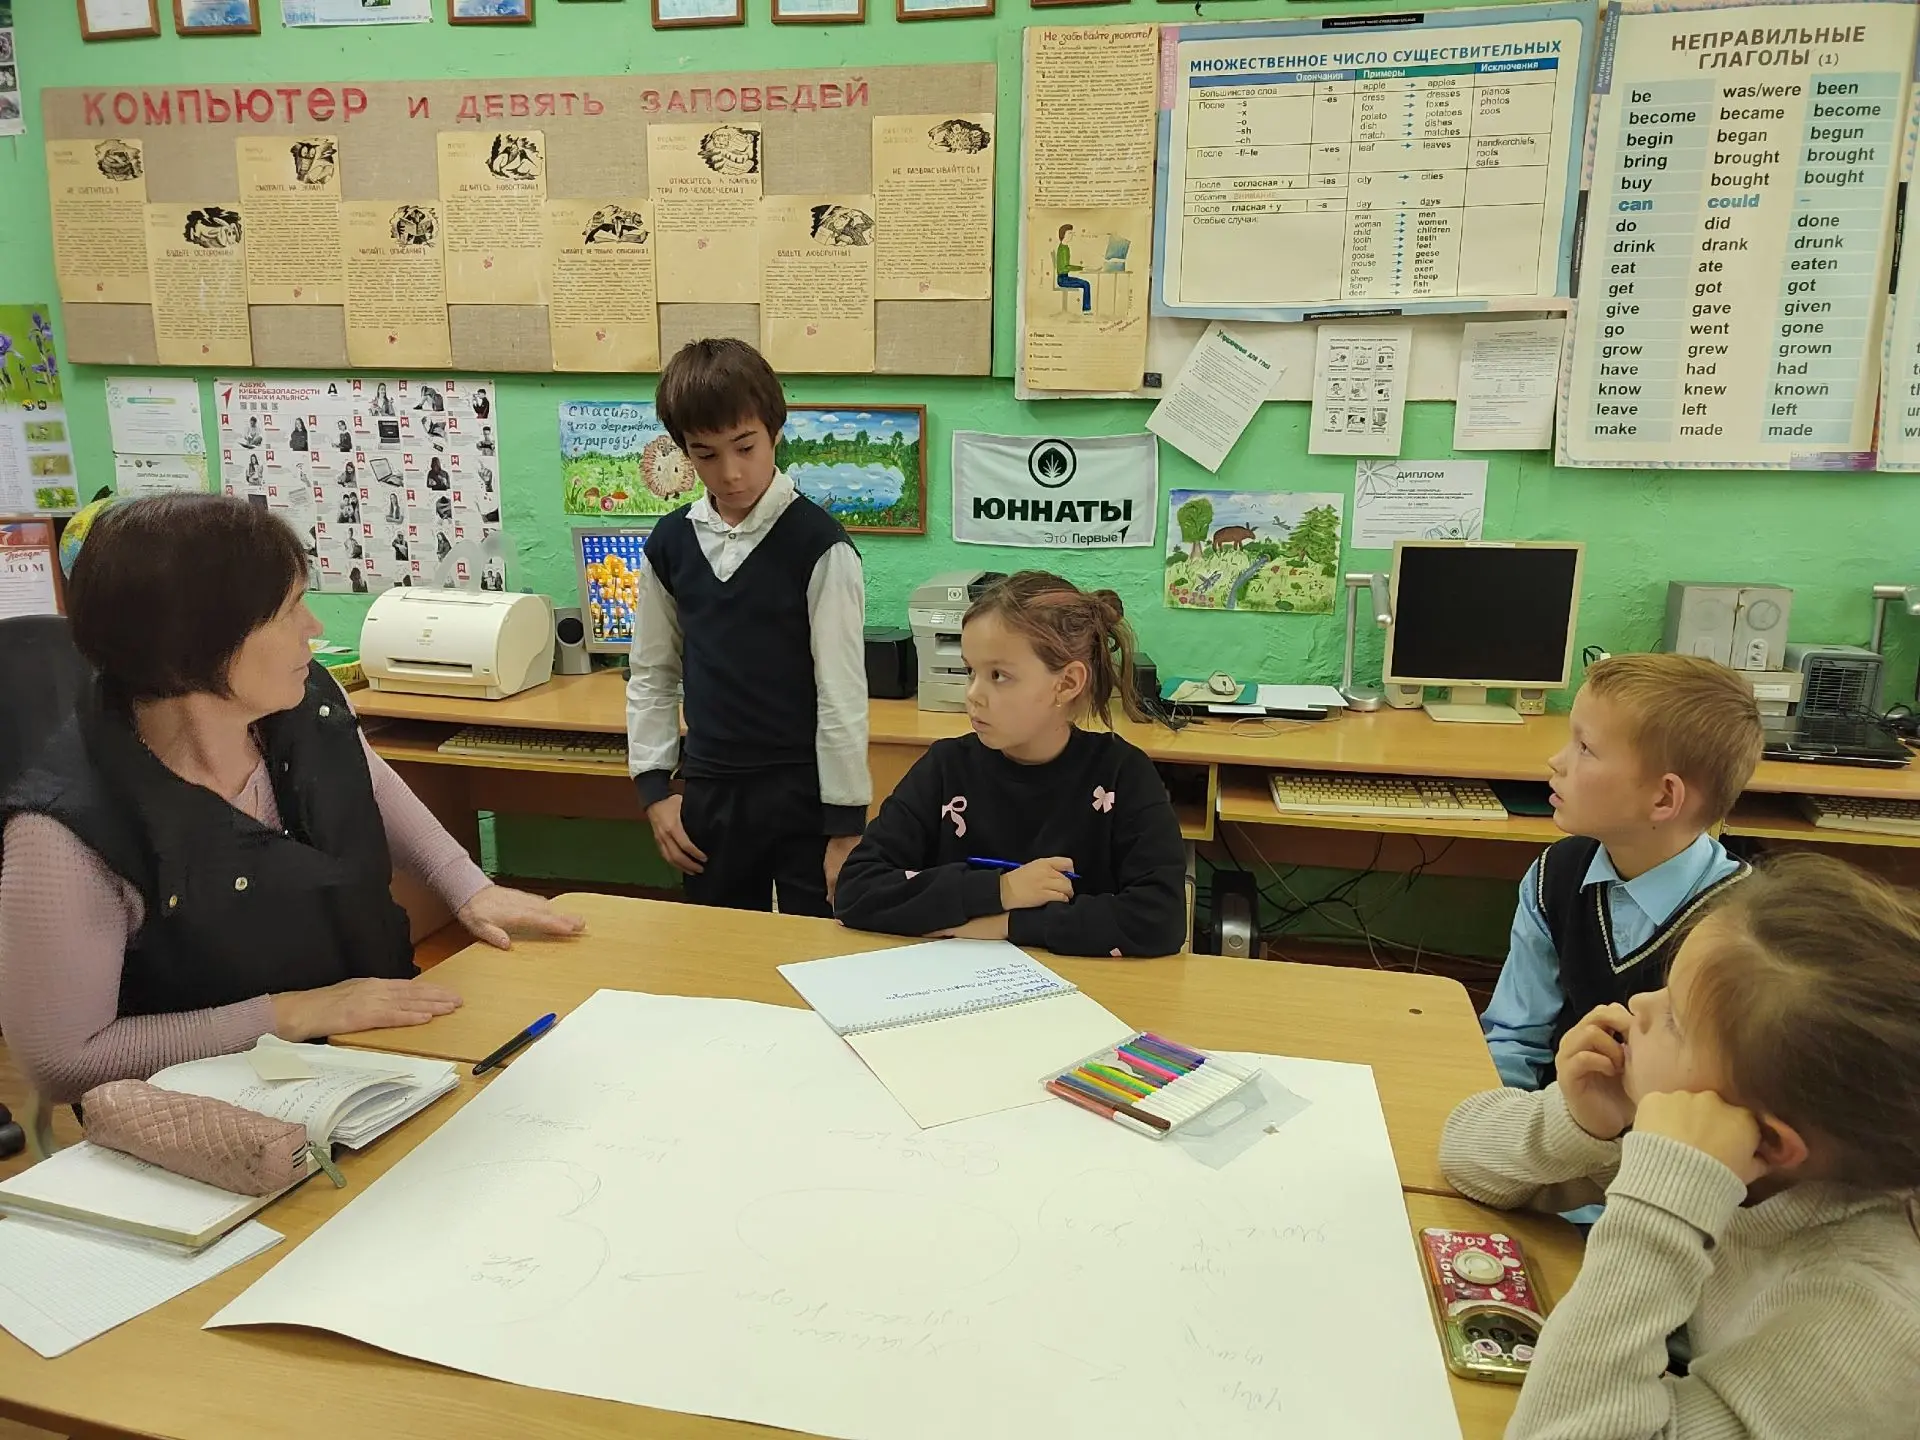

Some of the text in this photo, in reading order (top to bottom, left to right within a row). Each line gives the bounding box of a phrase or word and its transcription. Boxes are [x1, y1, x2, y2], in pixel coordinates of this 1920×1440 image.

[1044, 31, 1057, 41] Не
[1059, 29, 1109, 45] забывайте
[1671, 25, 1865, 52] НЕПРАВИЛЬНЫЕ
[1190, 40, 1561, 72] МНОЖЕСТВЕННОЕ ЧИСЛО СУЩЕСТВИТЕЛЬНЫХ
[1699, 49, 1839, 69] ГЛАГОЛЫ (1)
[1296, 61, 1538, 81] Окончания Примеры Исключения
[1363, 79, 1456, 90] apple apples
[1200, 89, 1255, 97] Большинство
[1362, 90, 1460, 101] dress dresses
[1482, 88, 1510, 96] pianos
[1631, 82, 1858, 102] be was/were been
[456, 91, 605, 123] ДЕВЯТЬ
[640, 76, 870, 114] ЗАПОВЕДЕЙ
[1362, 100, 1449, 111] fox foxes
[1480, 97, 1510, 107] photos
[1360, 109, 1463, 122] potato potatoes
[1480, 107, 1500, 115] zoos
[1629, 103, 1880, 124] become became become
[1360, 119, 1452, 130] dish dishes
[1359, 128, 1460, 139] match matches
[1626, 126, 1863, 148] begin began begun
[1359, 141, 1451, 152] leaf leaves
[1196, 150, 1222, 158] После
[1623, 147, 1874, 171] bring brought brought
[1476, 158, 1499, 166] safes
[1233, 180, 1278, 188] согласная
[1357, 176, 1372, 185] city
[1621, 170, 1864, 192] buy bought bought
[1357, 198, 1440, 208] day days
[1618, 194, 1759, 211] can could
[1615, 214, 1839, 232] do did done
[1613, 235, 1843, 253] drink drank drunk
[1415, 250, 1439, 258] geese
[1611, 257, 1837, 274] eat ate eaten
[1608, 279, 1816, 296] get got got
[1606, 299, 1831, 317] give gave given
[1604, 321, 1823, 338] go went gone
[1602, 342, 1832, 358] grow grew grown
[1600, 361, 1807, 376] have had had
[1598, 382, 1829, 396] know knew known
[1596, 402, 1796, 416] leave left left
[567, 421, 597, 432] что
[1594, 422, 1812, 436] make made made
[573, 434, 637, 450] природу!
[1396, 471, 1445, 480] ДИПЛОМ
[972, 496, 1133, 523] ЮННАТЫ
[1044, 532, 1118, 546] Это Первые
